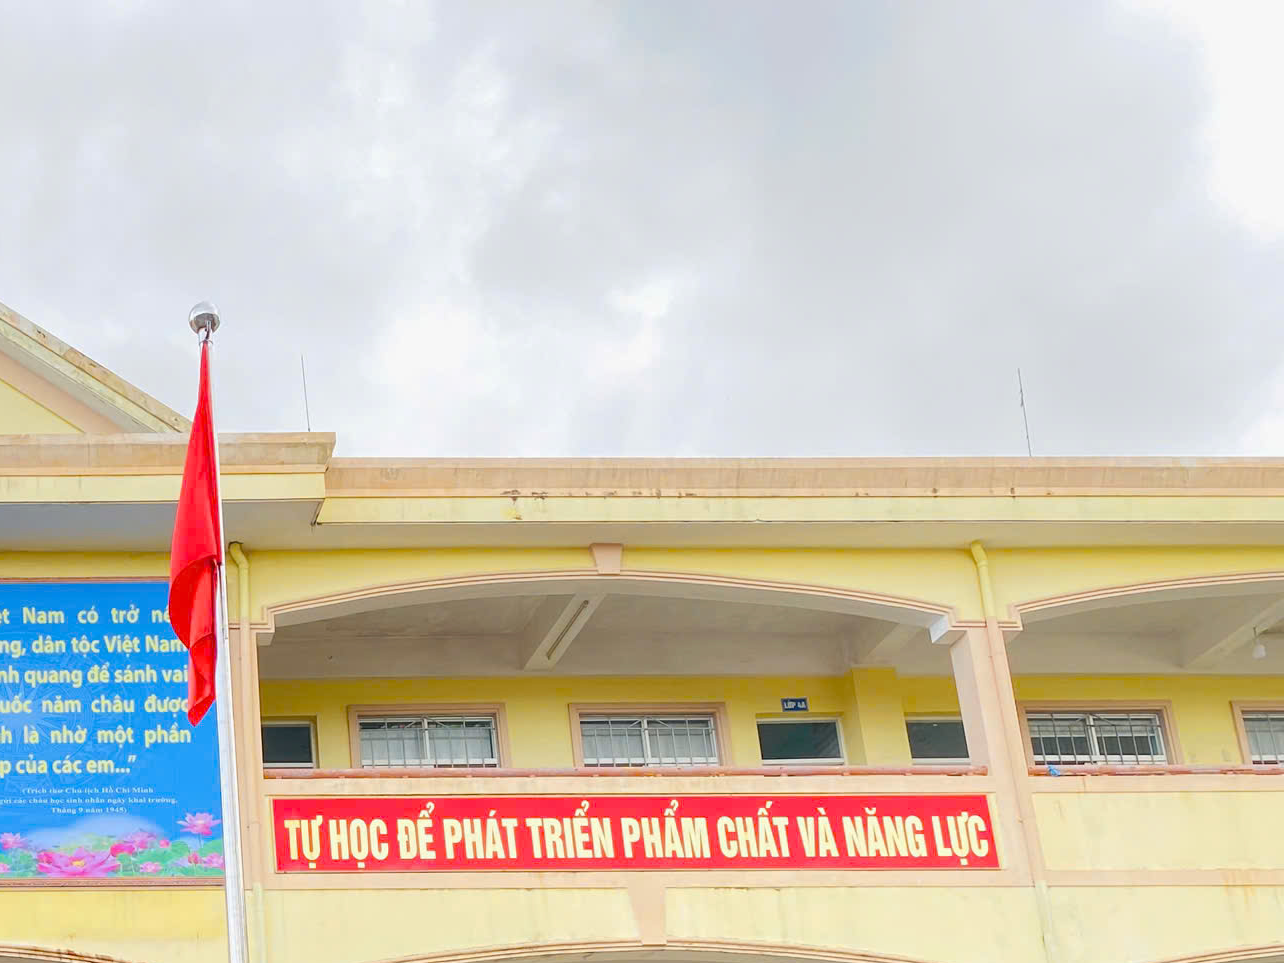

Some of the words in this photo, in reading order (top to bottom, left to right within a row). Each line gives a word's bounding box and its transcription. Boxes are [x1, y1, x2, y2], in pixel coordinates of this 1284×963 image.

[22, 606, 65, 624] Nam
[77, 605, 99, 624] có
[111, 604, 140, 624] trở
[31, 635, 66, 654] dân
[72, 635, 100, 658] tộc
[104, 635, 140, 657] Việt
[145, 635, 187, 653] Nam
[24, 669, 82, 688] quang
[87, 662, 110, 683] để
[115, 664, 157, 683] sánh
[162, 664, 188, 683] vai
[42, 696, 81, 714] năm
[91, 695, 135, 713] châu
[23, 725, 40, 743] là
[50, 724, 87, 743] nhờ
[97, 726, 134, 748] một
[144, 722, 191, 748] phần
[16, 754, 47, 774] của
[53, 756, 82, 774] các
[284, 815, 323, 869] TỰ
[329, 818, 389, 869] HỌC
[397, 802, 437, 859] ĐỂ
[443, 809, 518, 859] PHÁT
[525, 800, 615, 859] TRIỂN
[620, 799, 711, 859] PHẨM
[716, 801, 789, 858] CHẤT
[797, 807, 840, 858] VÀ
[842, 807, 926, 857] NĂNG
[931, 812, 989, 866] LỰC
